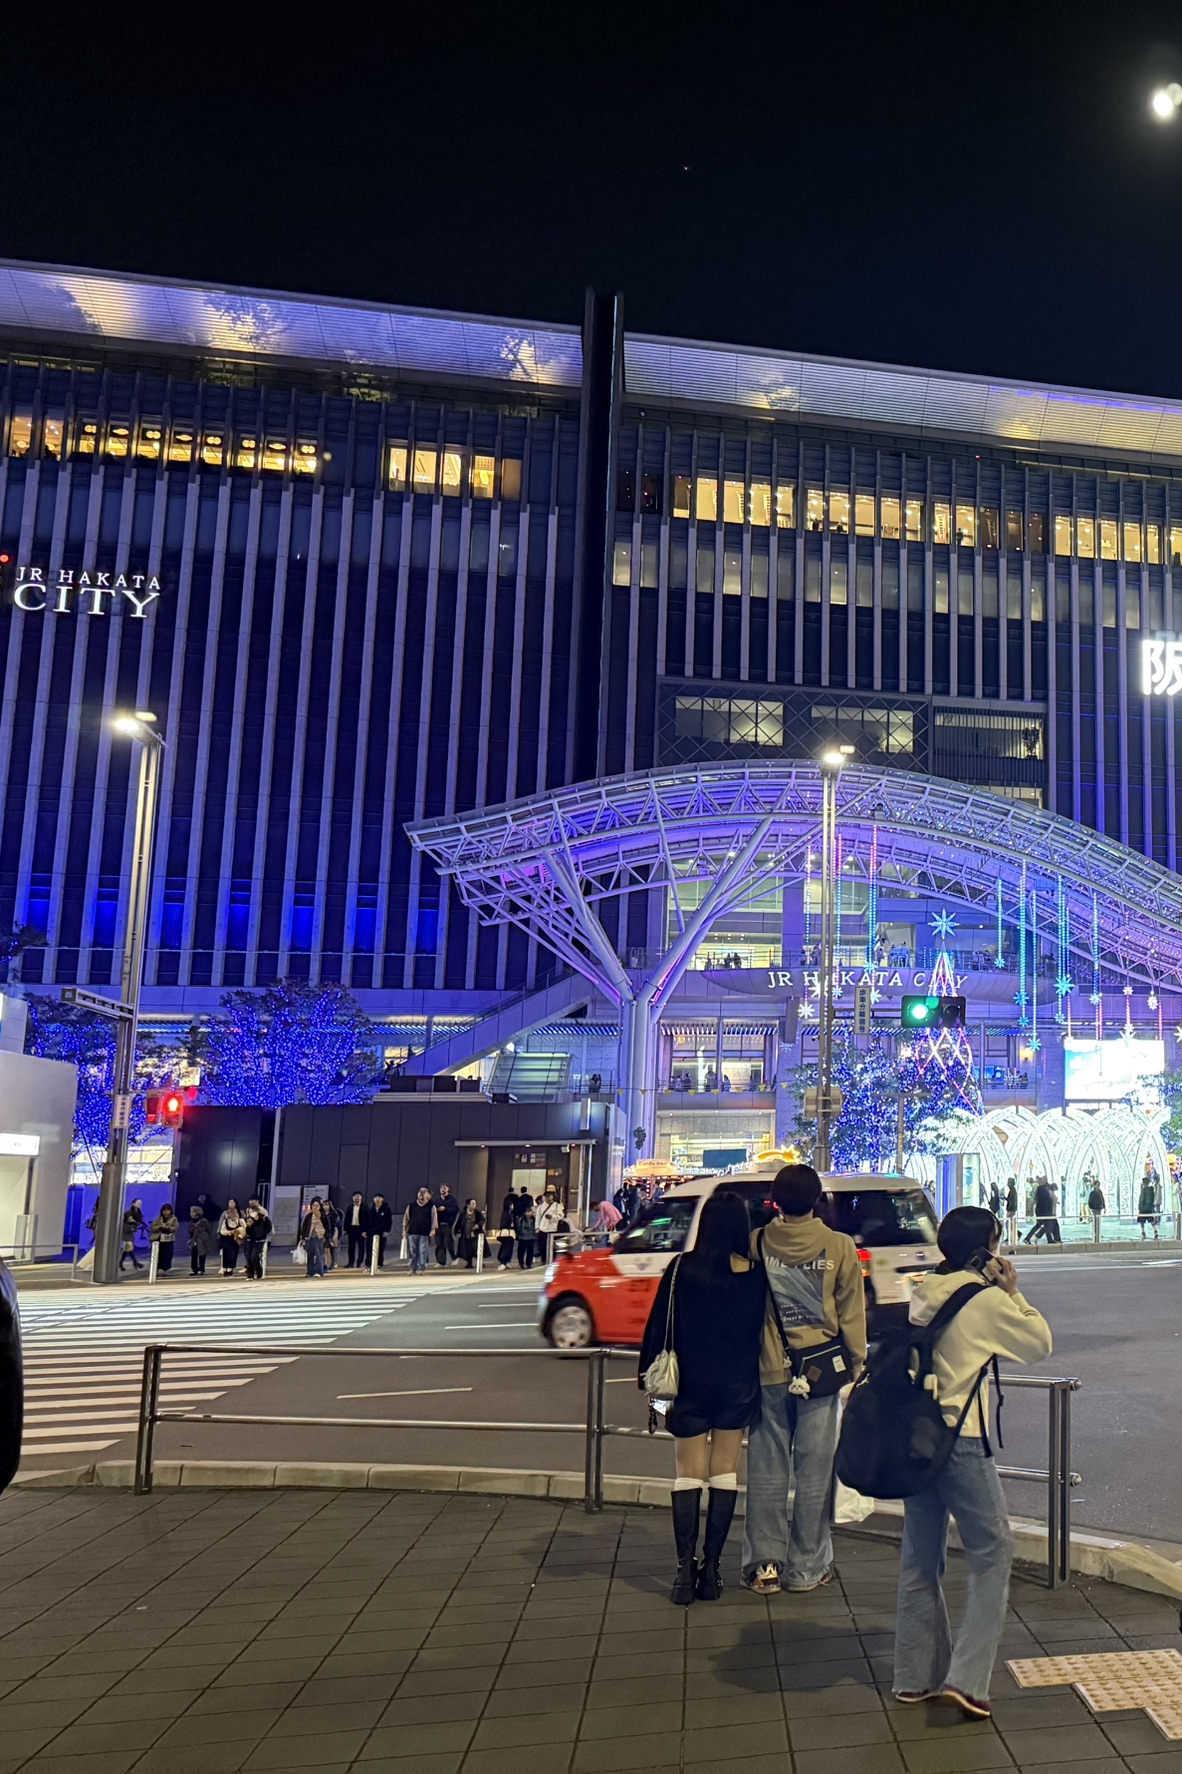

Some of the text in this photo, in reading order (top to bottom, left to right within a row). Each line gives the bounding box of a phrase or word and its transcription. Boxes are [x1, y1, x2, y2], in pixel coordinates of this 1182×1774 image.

[16, 567, 161, 590] JR HAKATA
[14, 583, 160, 618] CITY
[767, 971, 793, 988] JR
[802, 970, 903, 988] HKATA
